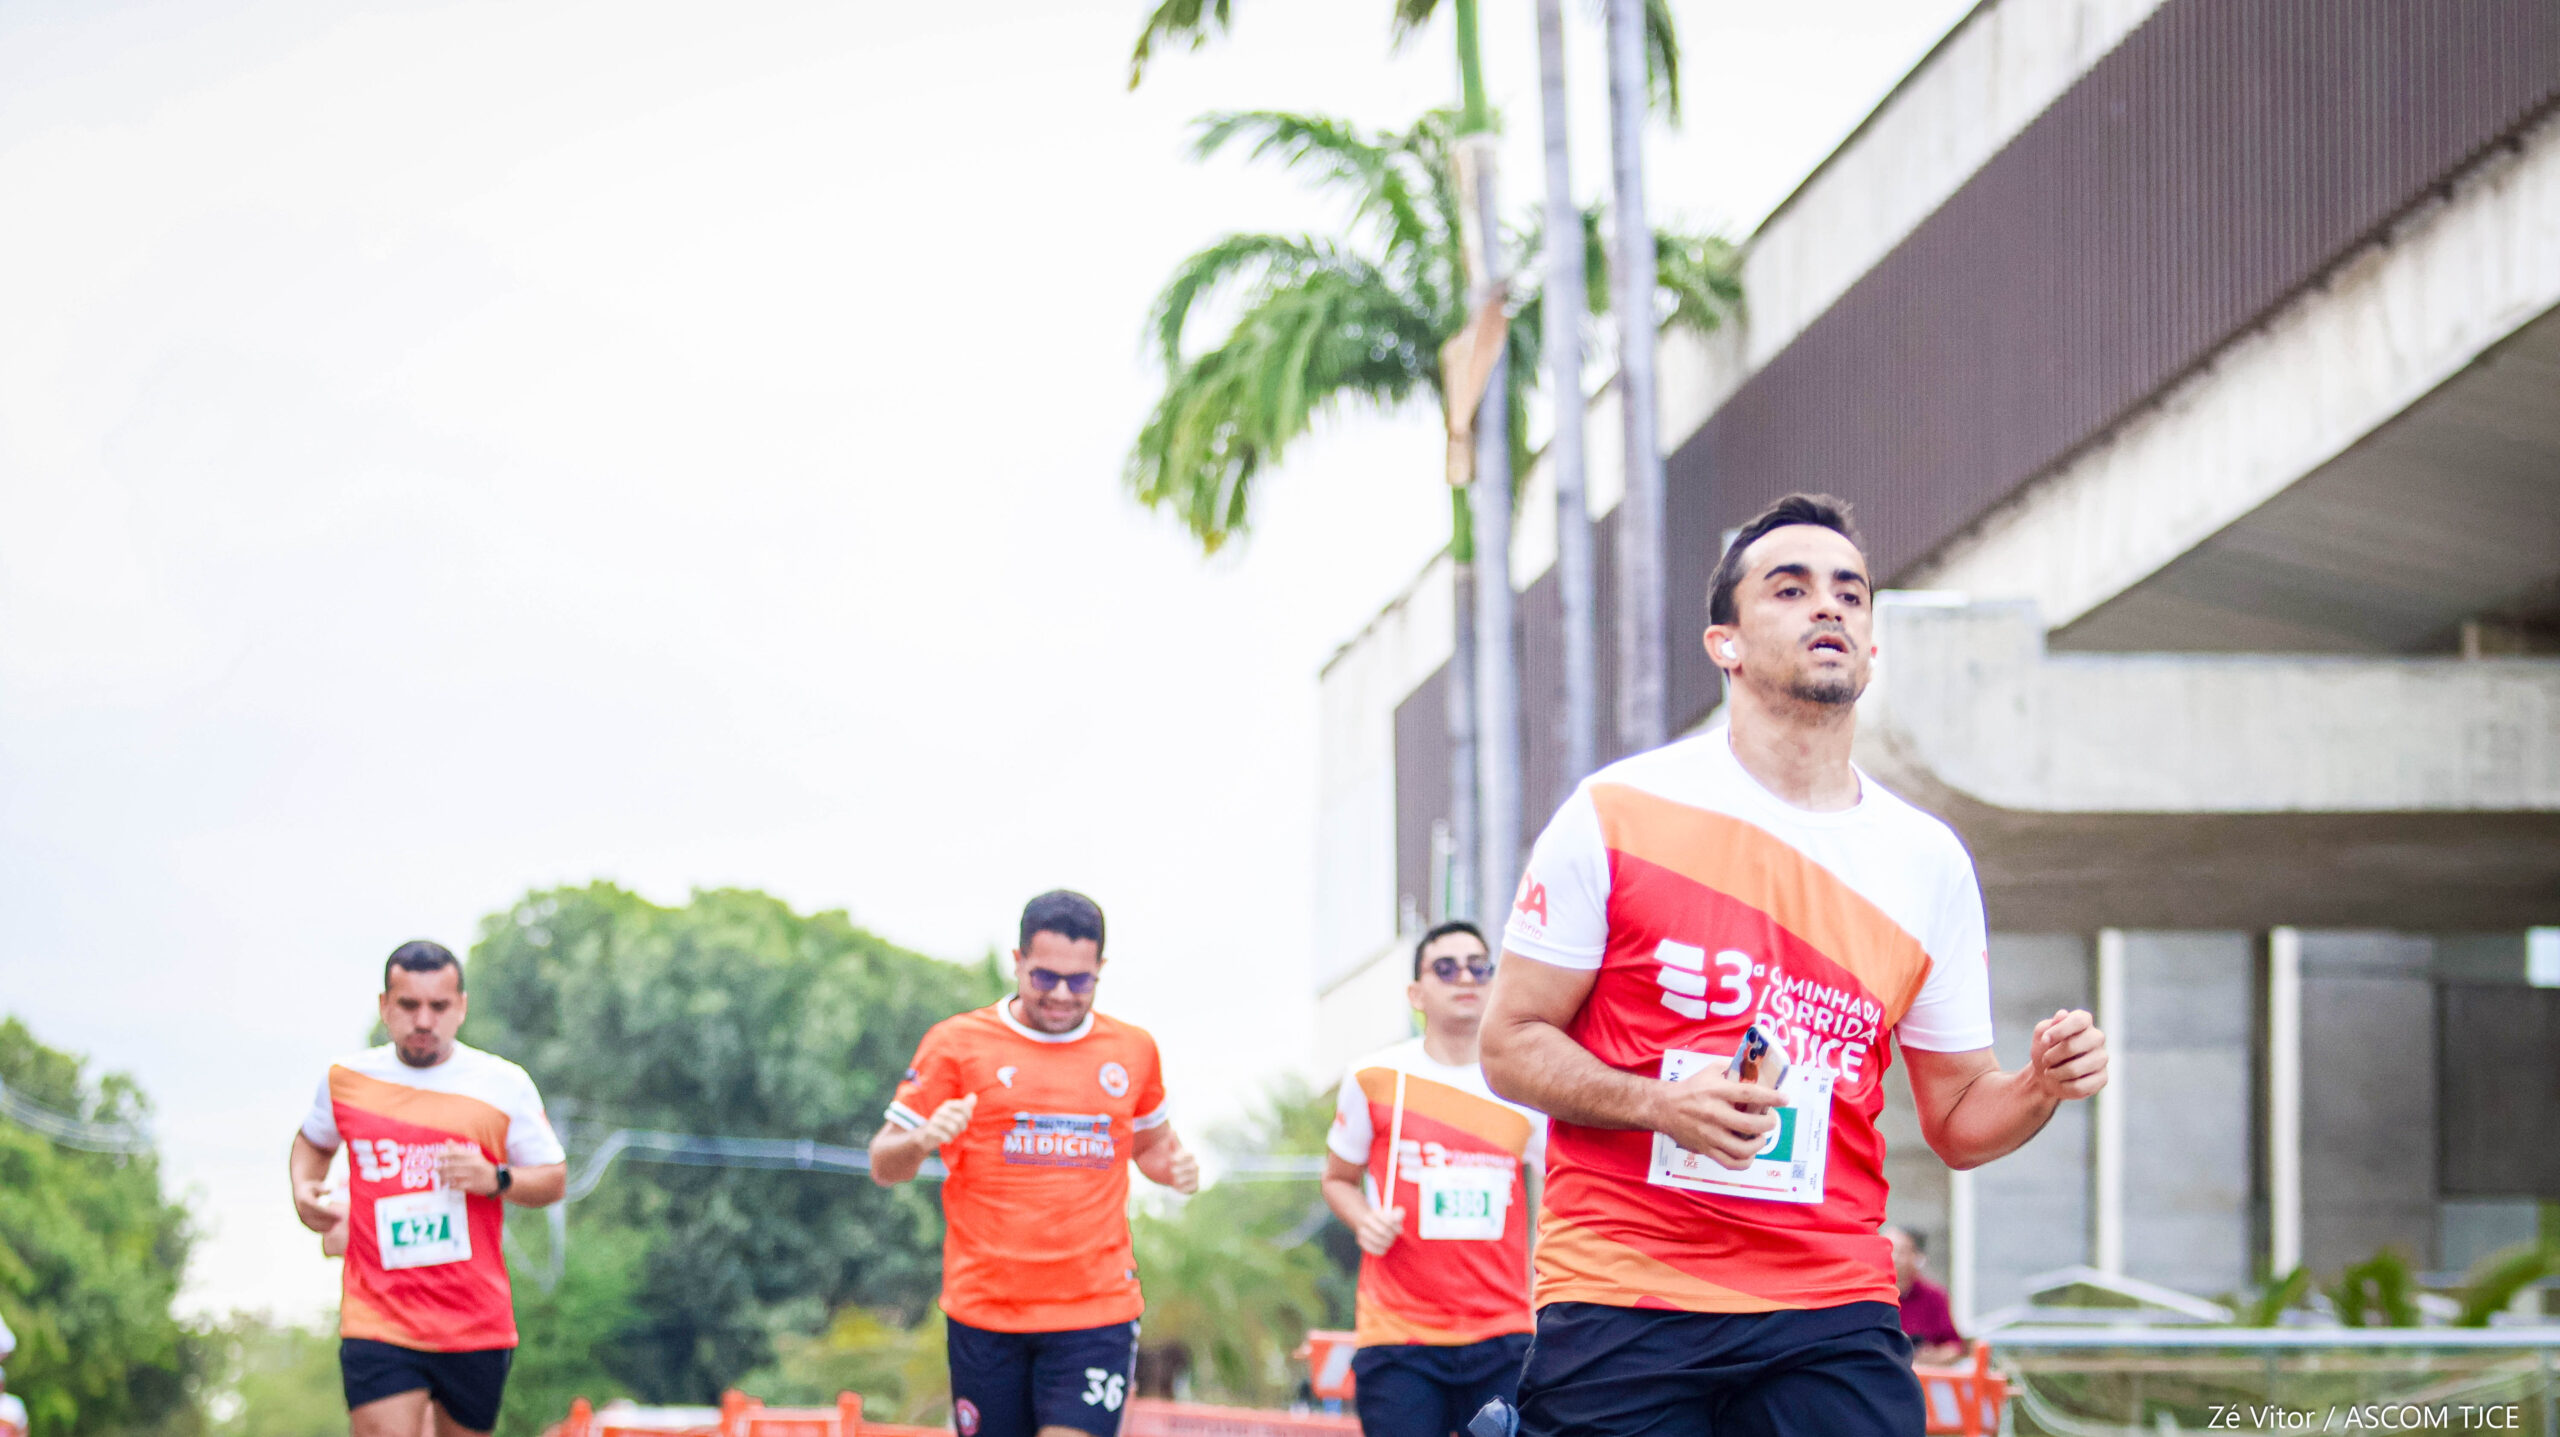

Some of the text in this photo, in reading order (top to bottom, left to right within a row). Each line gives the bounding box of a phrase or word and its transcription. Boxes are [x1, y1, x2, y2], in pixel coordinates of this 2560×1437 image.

[1004, 1134, 1115, 1158] MEDICINA
[397, 1216, 444, 1245] 427
[1082, 1367, 1125, 1412] 36
